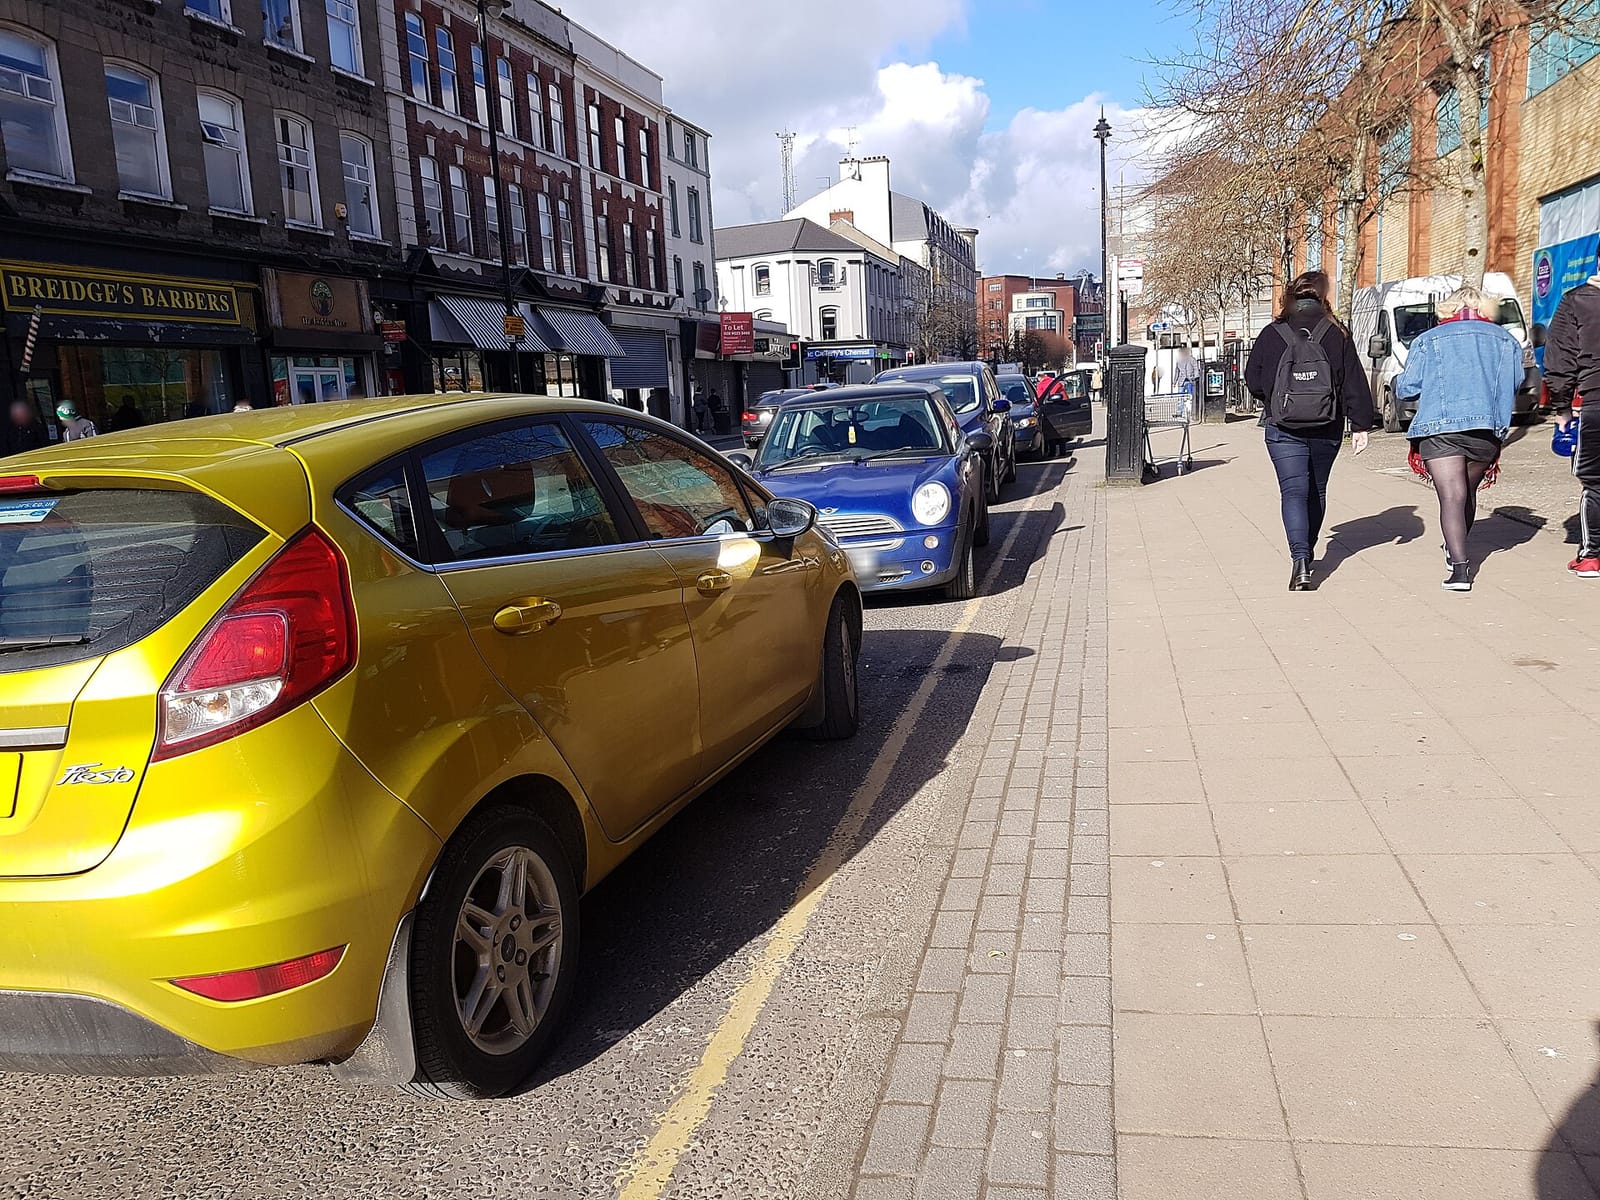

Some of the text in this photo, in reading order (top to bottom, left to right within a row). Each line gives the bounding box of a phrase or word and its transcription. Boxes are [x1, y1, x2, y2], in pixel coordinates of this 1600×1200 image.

[10, 274, 231, 313] BREIDGE'S BARBERS
[56, 763, 135, 785] Fiesta
